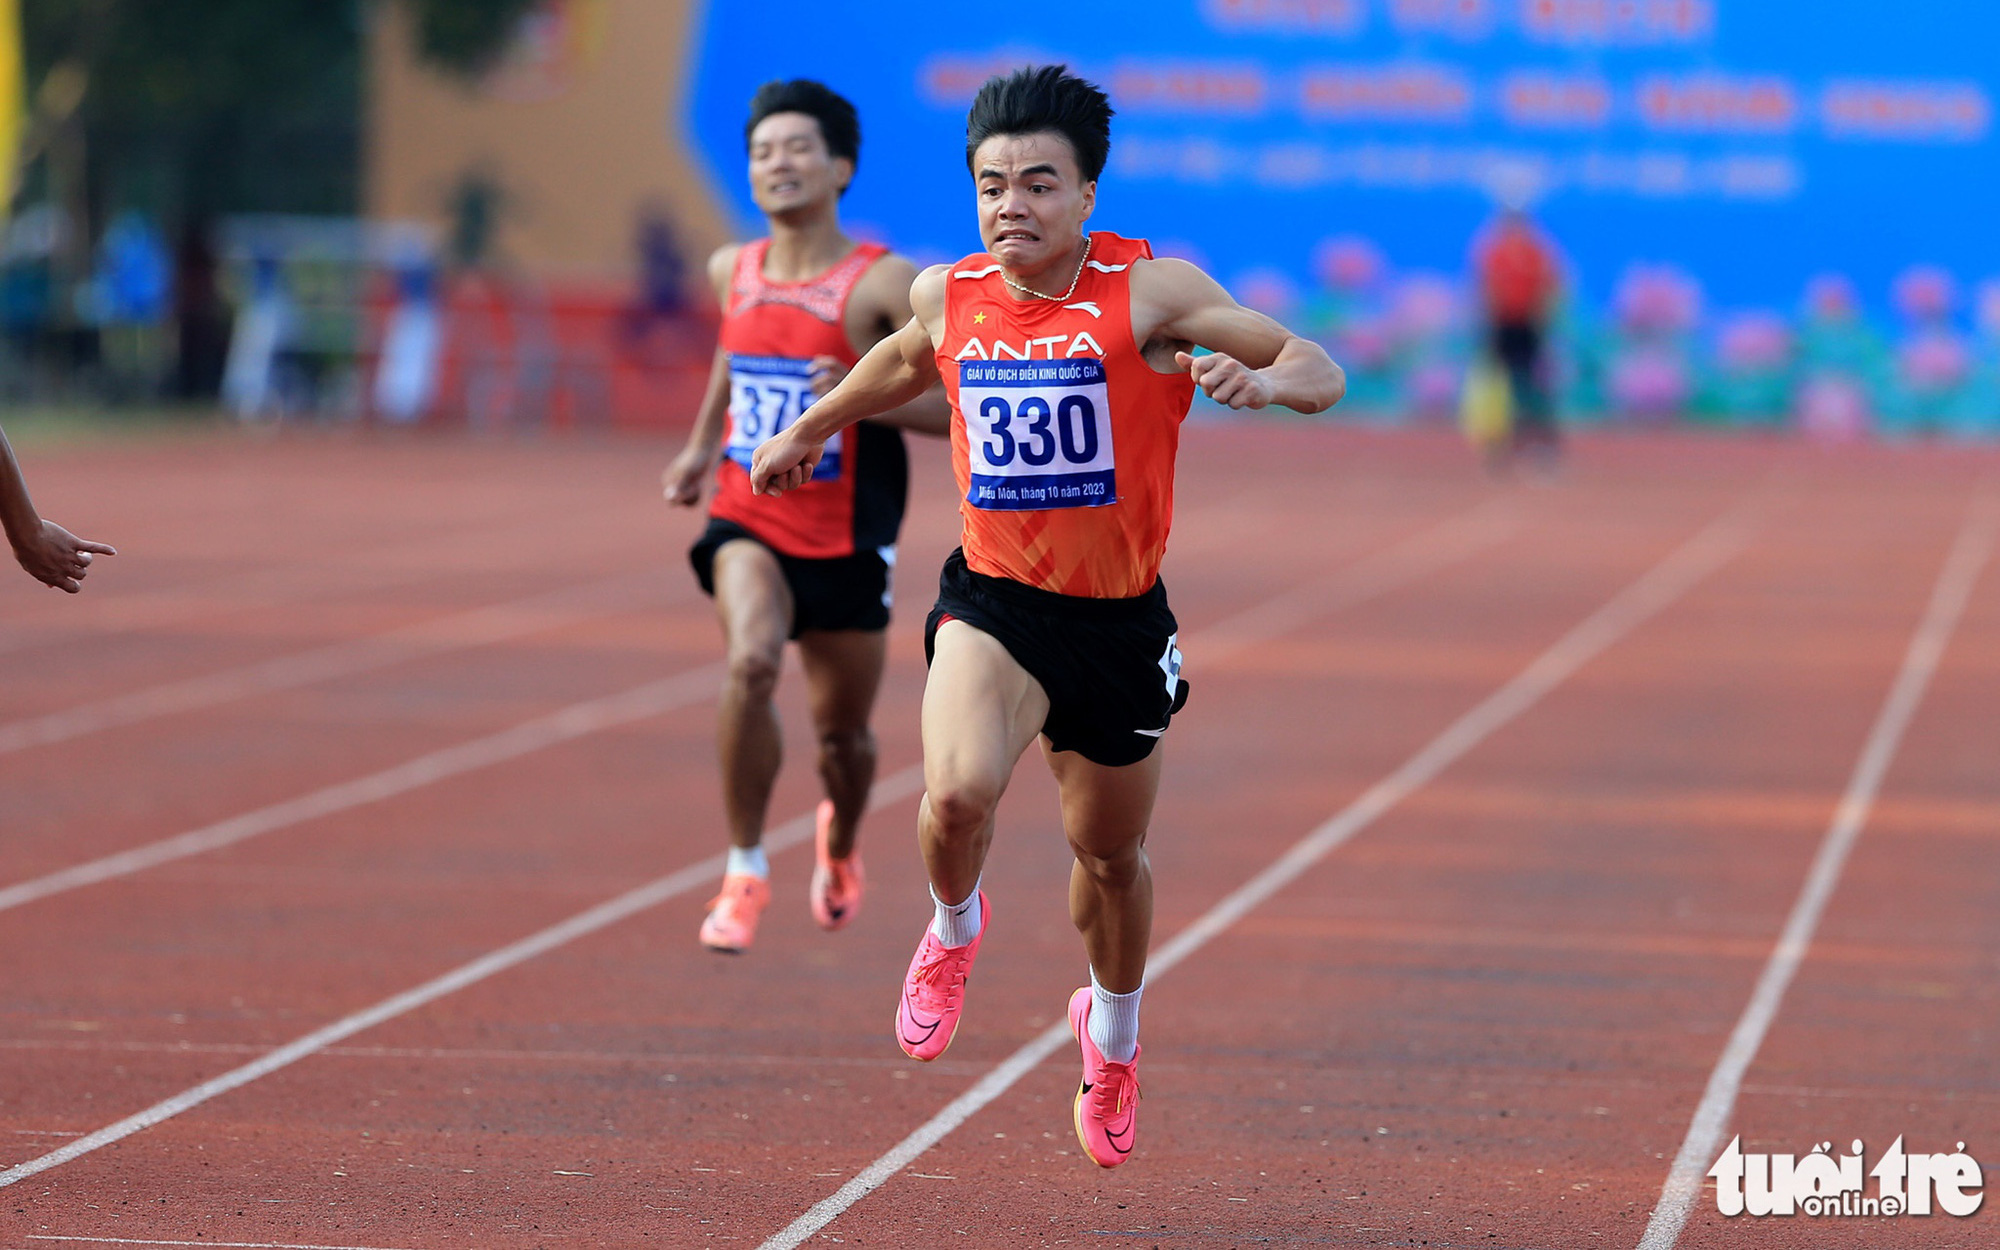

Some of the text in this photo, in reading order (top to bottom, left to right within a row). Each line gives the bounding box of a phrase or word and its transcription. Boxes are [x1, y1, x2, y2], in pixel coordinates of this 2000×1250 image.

[955, 331, 1104, 361] ANTA
[997, 368, 1018, 383] ĐỊCH
[1039, 368, 1057, 380] KINH
[1058, 363, 1082, 380] QUỐC
[1083, 366, 1099, 378] GIA
[979, 394, 1099, 467] 330
[1021, 486, 1046, 501] tháng
[1048, 486, 1059, 498] 10
[1061, 485, 1081, 498] năm
[1082, 482, 1105, 496] 2023
